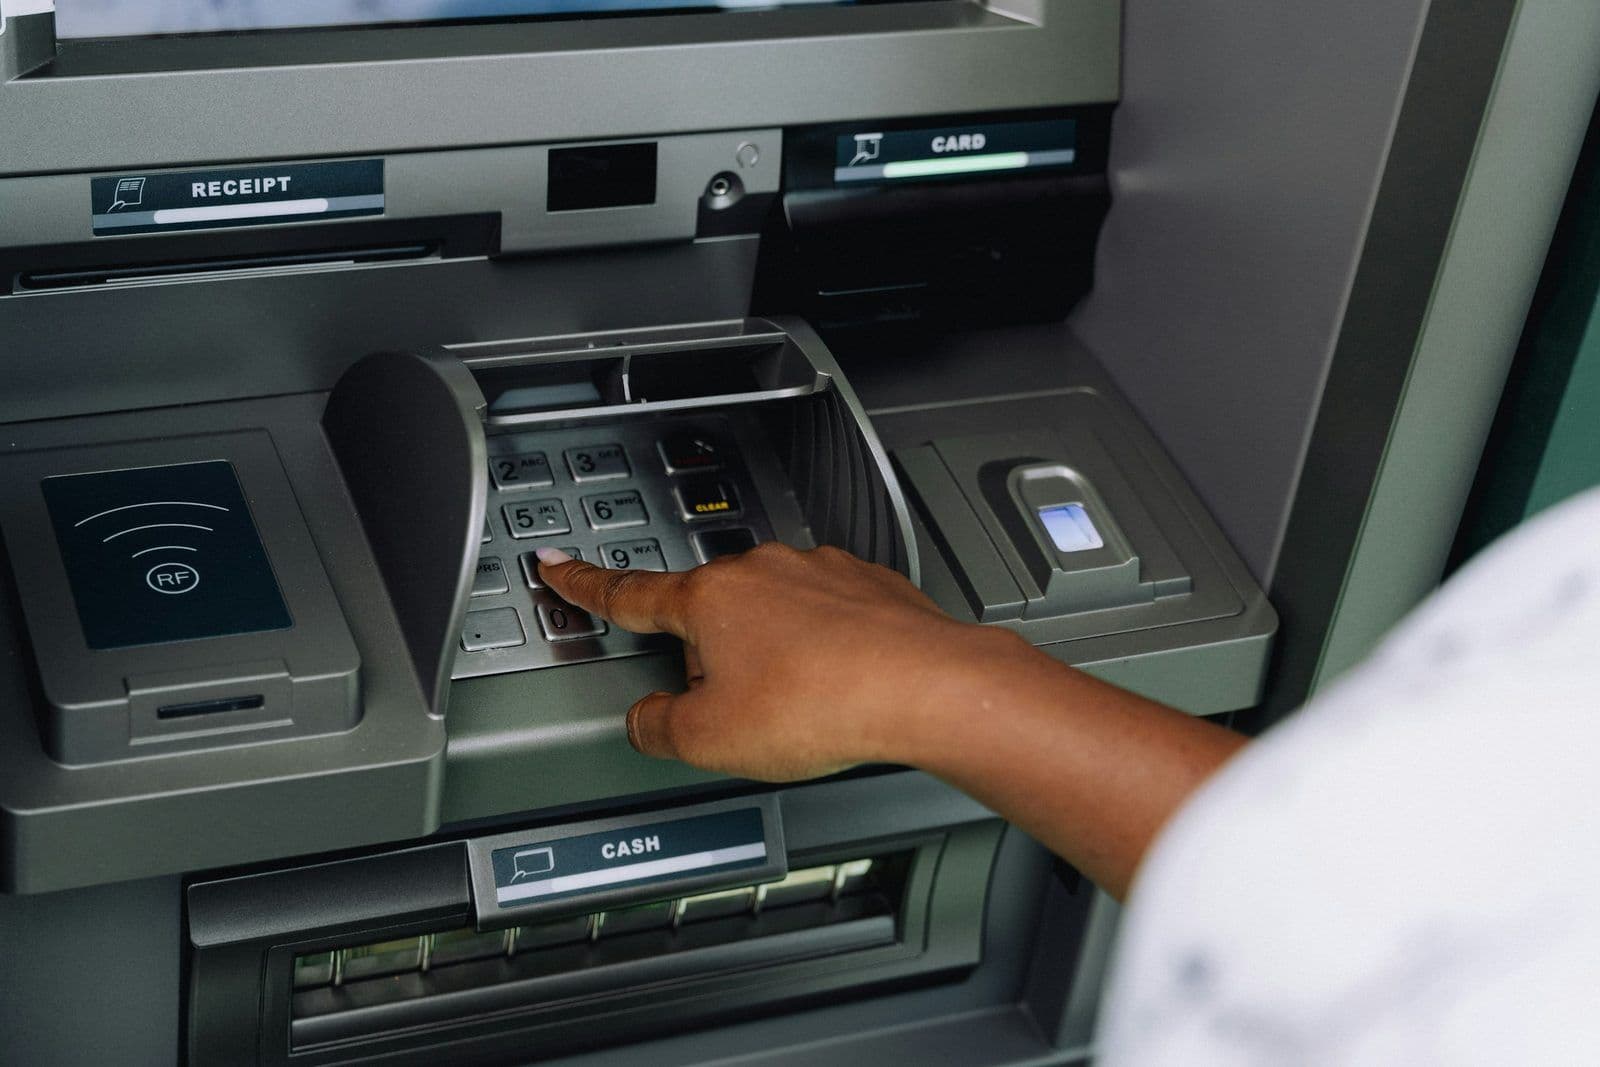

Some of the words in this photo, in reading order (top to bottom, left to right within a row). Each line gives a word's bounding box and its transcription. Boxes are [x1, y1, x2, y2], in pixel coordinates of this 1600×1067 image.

[931, 134, 986, 153] CARD
[191, 176, 291, 198] RECEIPT
[500, 462, 519, 481] 2
[576, 453, 596, 473] 3
[594, 500, 613, 520] 6
[695, 501, 729, 512] CLEAR
[516, 508, 534, 528] 5
[611, 549, 631, 569] 9
[157, 571, 190, 587] RF
[550, 607, 568, 629] 0
[601, 835, 661, 859] CASH
